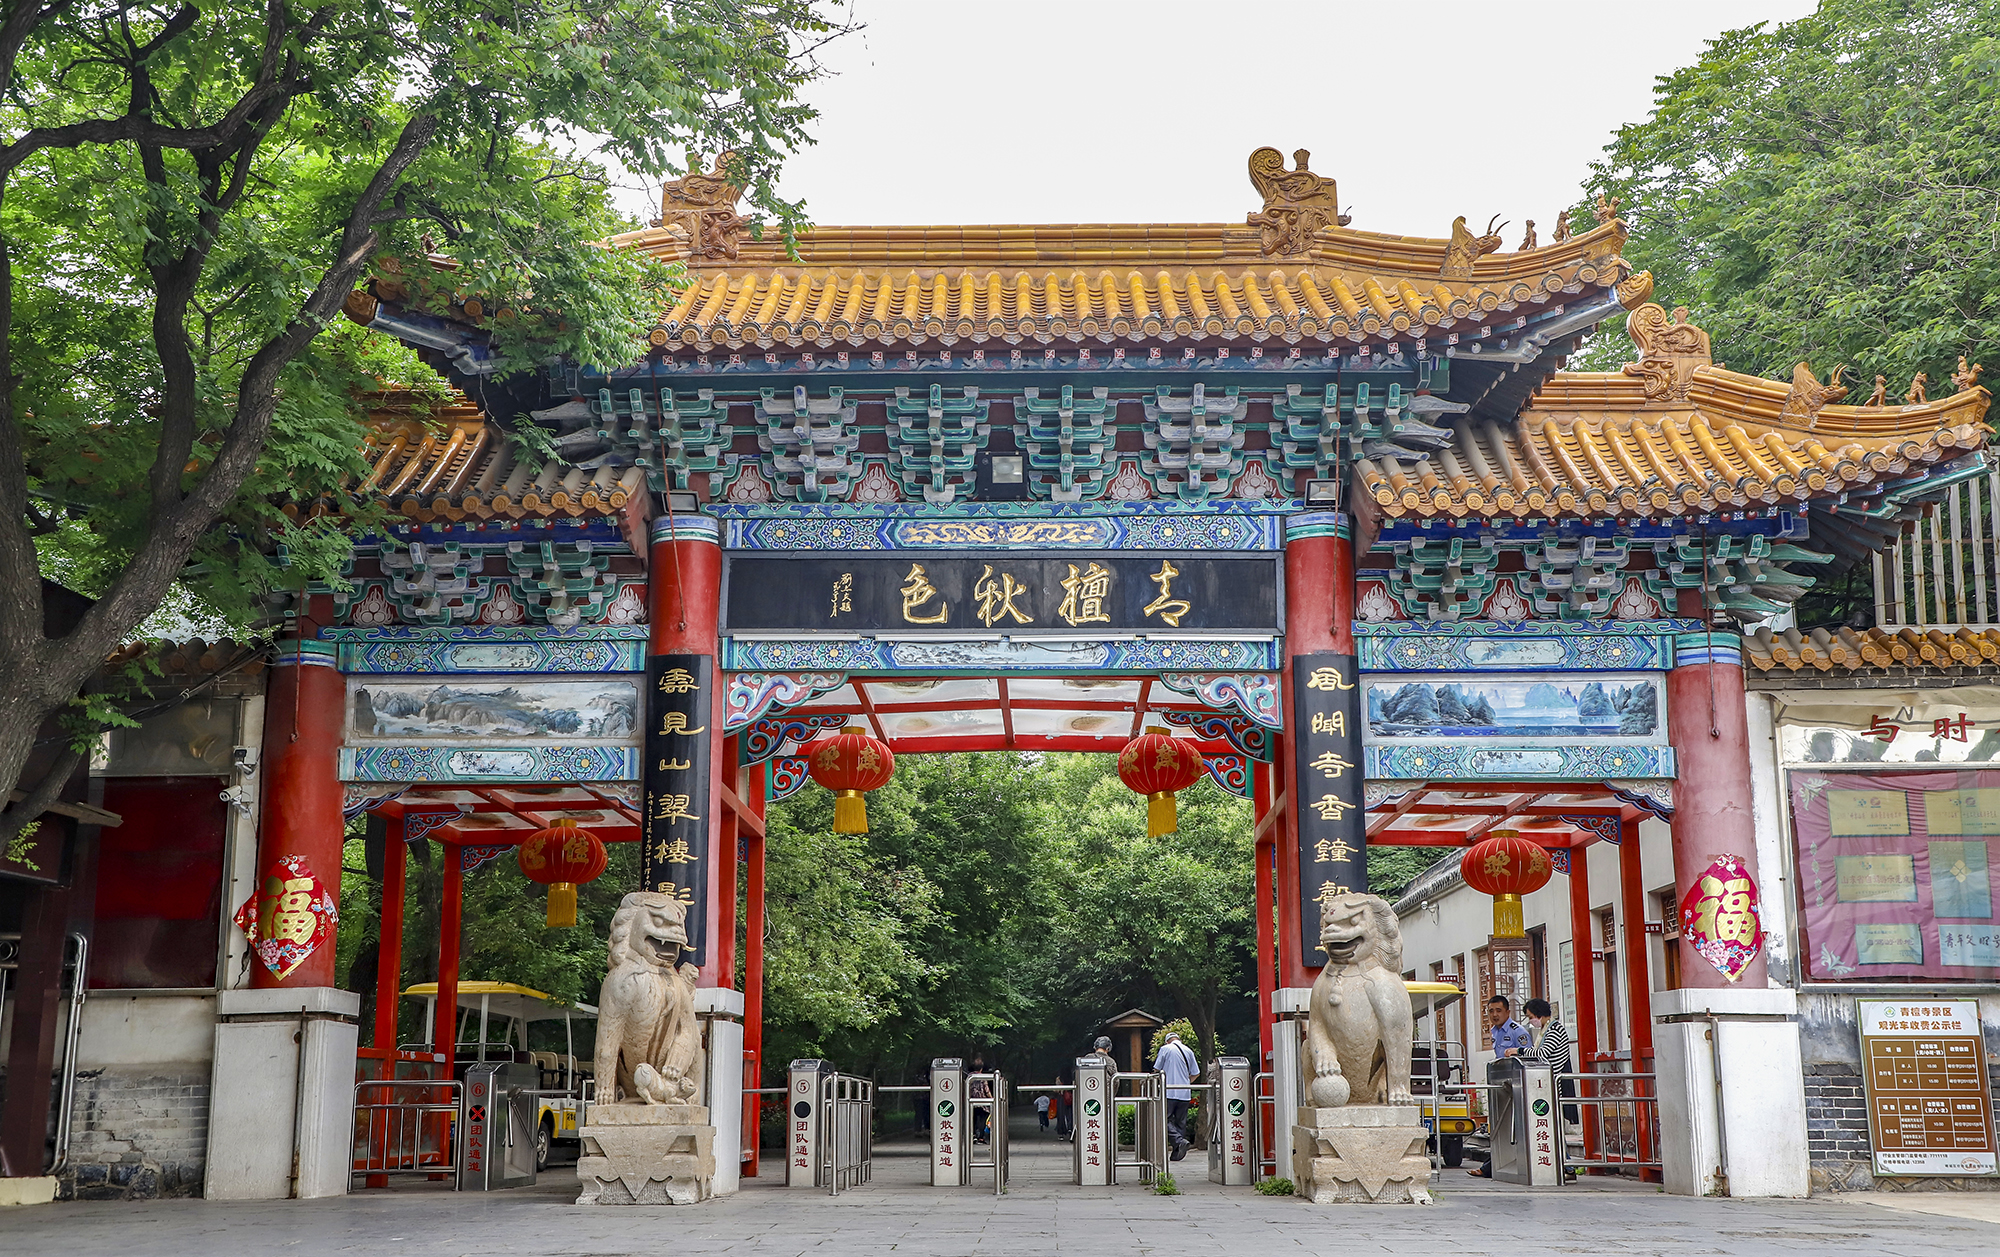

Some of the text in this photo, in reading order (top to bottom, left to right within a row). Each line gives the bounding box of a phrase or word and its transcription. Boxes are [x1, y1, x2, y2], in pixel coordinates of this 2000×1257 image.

[1861, 713, 2000, 743] 与时
[654, 668, 706, 951] 雲見山翠樓影
[1306, 666, 1359, 951] 風聞寺香鐘聲
[258, 874, 317, 945] 福
[1694, 874, 1757, 947] 福
[1878, 1020, 1962, 1031] 观光车收费公示栏
[1900, 1007, 1952, 1017] 青檀寺景区
[467, 1125, 483, 1172] 团队通道
[794, 1121, 809, 1168] 团队通道
[939, 1120, 954, 1167] 散客通道
[1086, 1119, 1100, 1167] 散客通道
[1231, 1119, 1245, 1166] 散客通道
[1536, 1119, 1552, 1167] 网络通道
